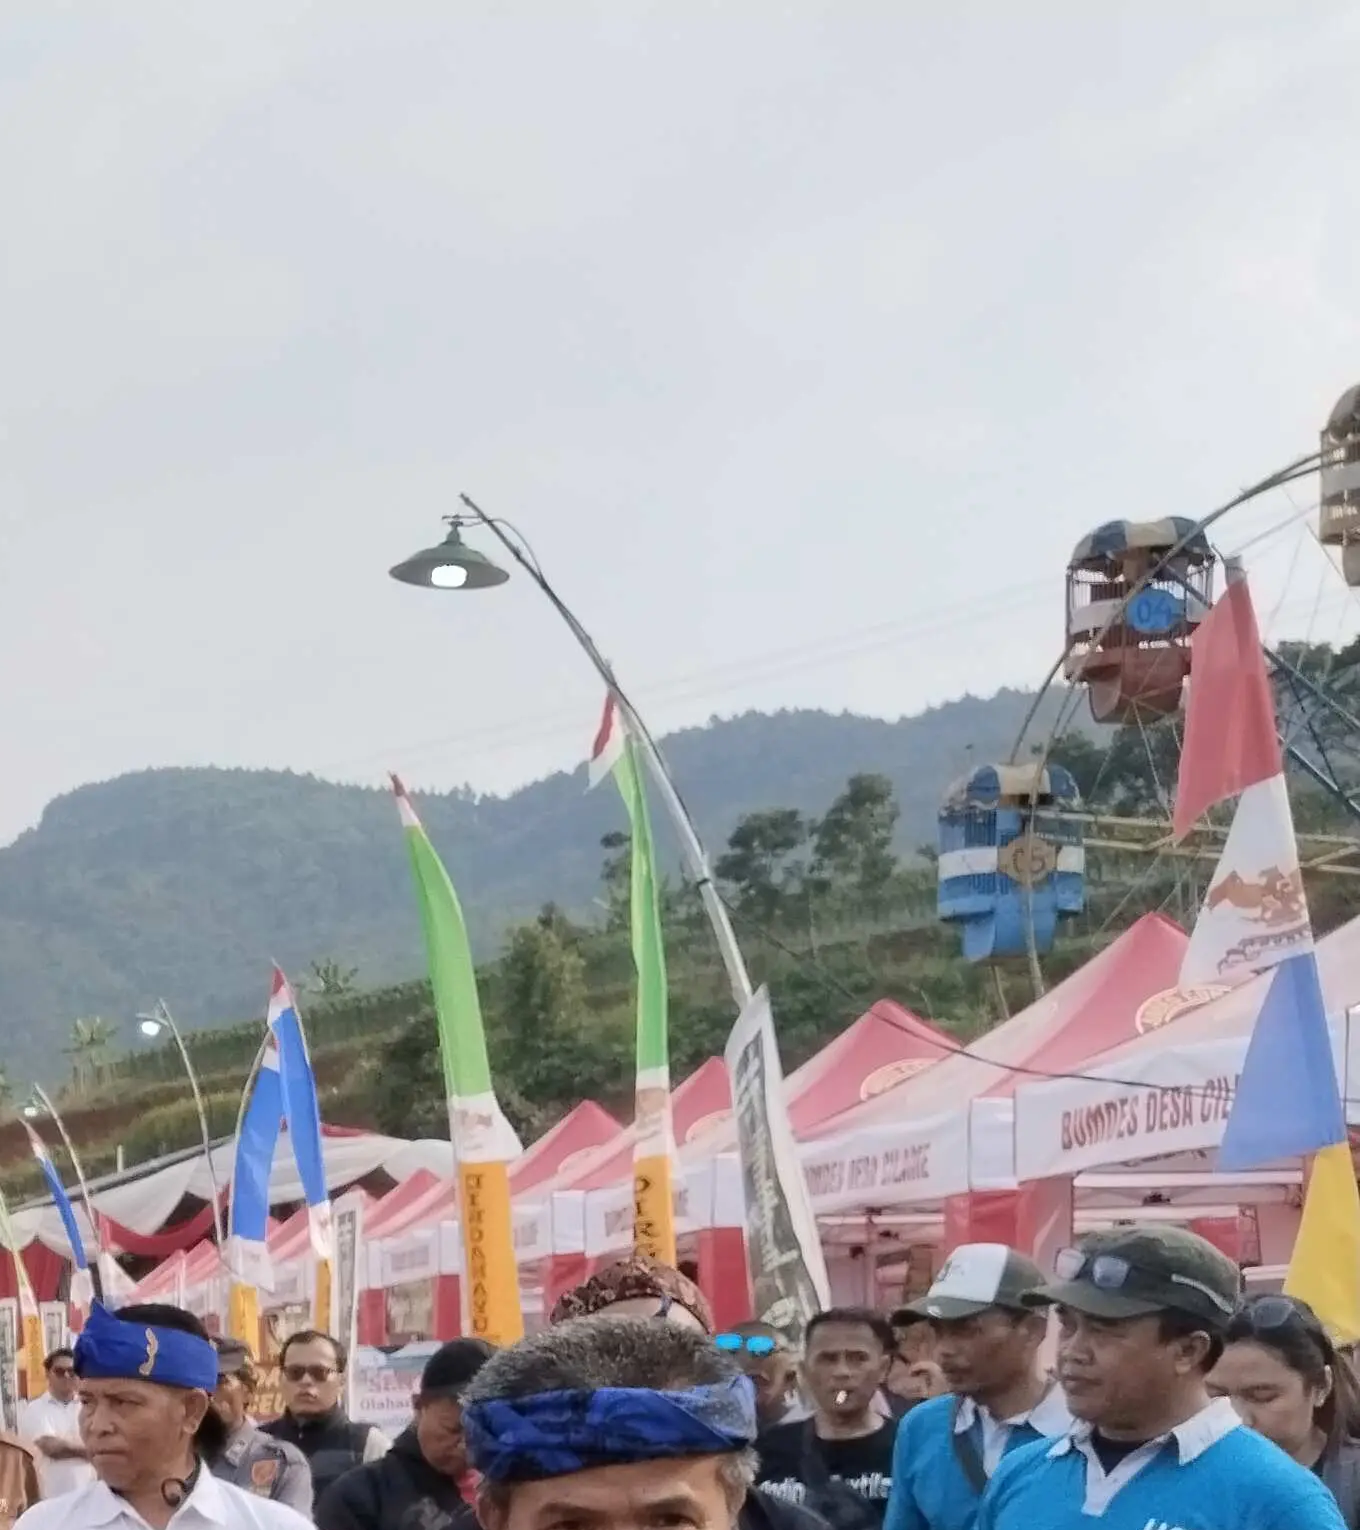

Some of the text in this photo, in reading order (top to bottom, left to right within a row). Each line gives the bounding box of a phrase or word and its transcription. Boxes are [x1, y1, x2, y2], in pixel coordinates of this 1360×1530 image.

[1060, 1073, 1241, 1151] BUMDES DESA CIL
